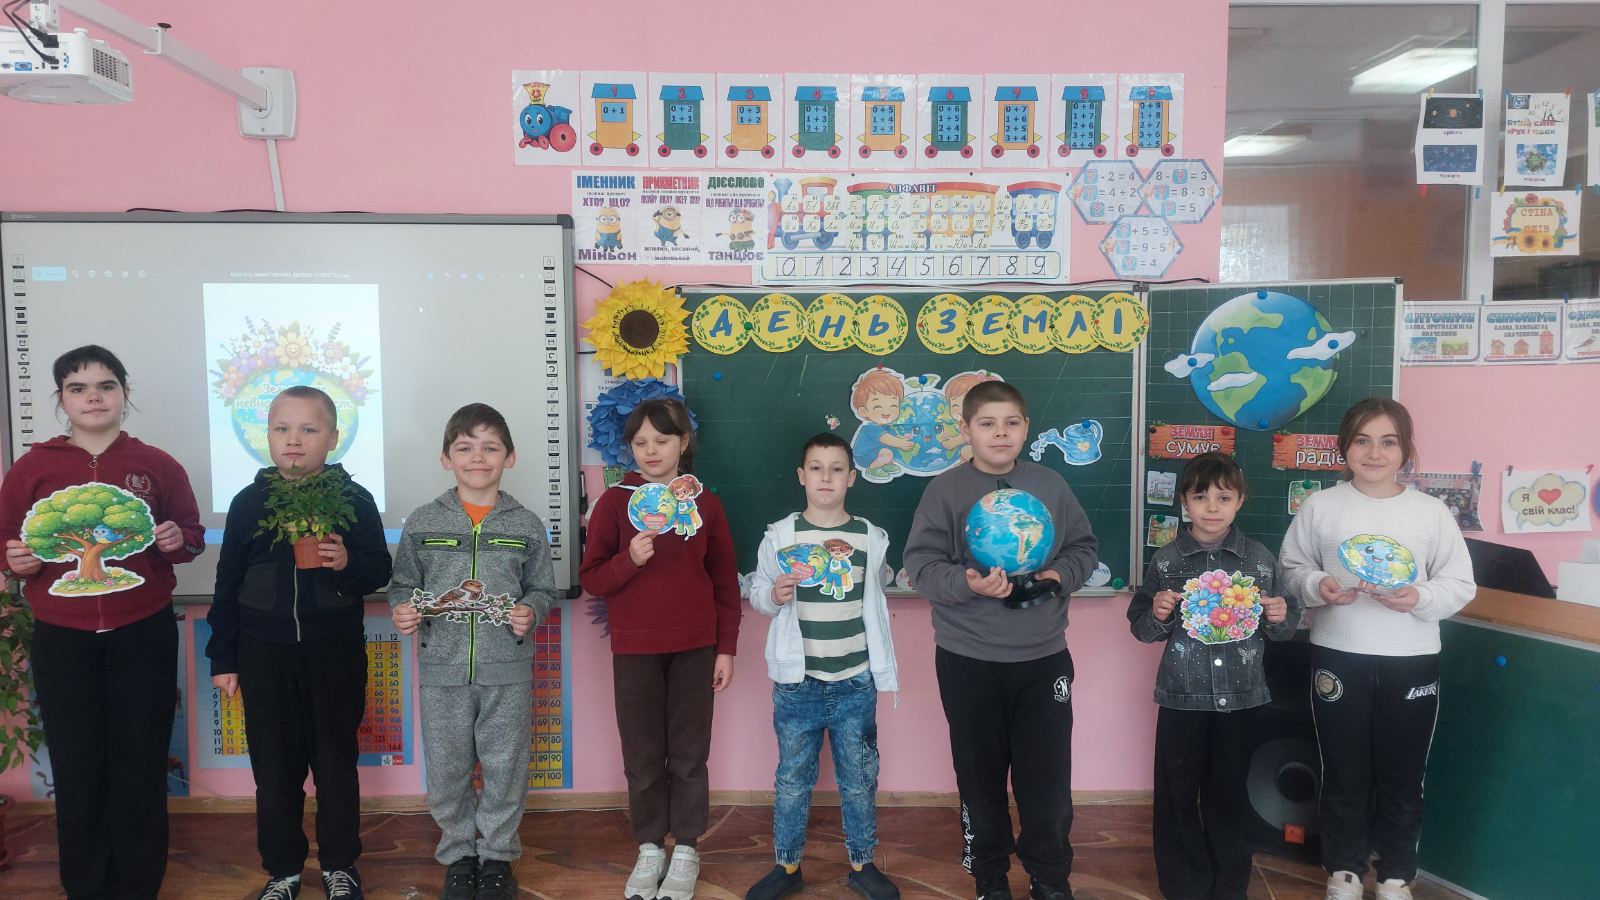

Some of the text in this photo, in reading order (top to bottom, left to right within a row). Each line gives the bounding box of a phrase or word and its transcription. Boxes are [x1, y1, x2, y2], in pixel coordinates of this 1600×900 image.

[1108, 172, 1135, 181] 2 4
[1156, 171, 1208, 180] 8 3
[577, 176, 635, 189] ІМЕННИК
[642, 176, 700, 189] ПРИКМЕТНИК
[708, 176, 764, 189] ДІЄСЛОВО
[886, 184, 938, 193] АЛФАВІТ
[1109, 188, 1116, 197] 4
[1130, 188, 1136, 197] 2
[1181, 188, 1205, 197] 8 3
[583, 198, 630, 208] ХТО? ЩО?
[1189, 203, 1196, 212] 5
[1118, 204, 1125, 213] 6
[1521, 208, 1554, 217] СТІНА
[1142, 227, 1149, 236] 5
[1162, 227, 1169, 236] 9
[1142, 243, 1166, 252] 9 5
[578, 249, 636, 261] Міньон
[708, 250, 764, 262] танцює
[782, 256, 1045, 276] 0 1 2 3 4 5 6 7 8 9
[1150, 259, 1156, 267] 4
[1404, 312, 1475, 323] АНТОНІМИ
[1487, 312, 1556, 323] СИНОНІМИ
[709, 308, 1122, 338] ДЕНЬ ЗЕМЛІ
[1170, 426, 1214, 440] ЗЕМЛЯ
[1296, 435, 1338, 449] ЗЕМЛ
[1296, 449, 1346, 467] радіє
[1522, 494, 1529, 502] Я
[1522, 505, 1576, 515] свій клас!
[1405, 686, 1437, 700] LAKERS
